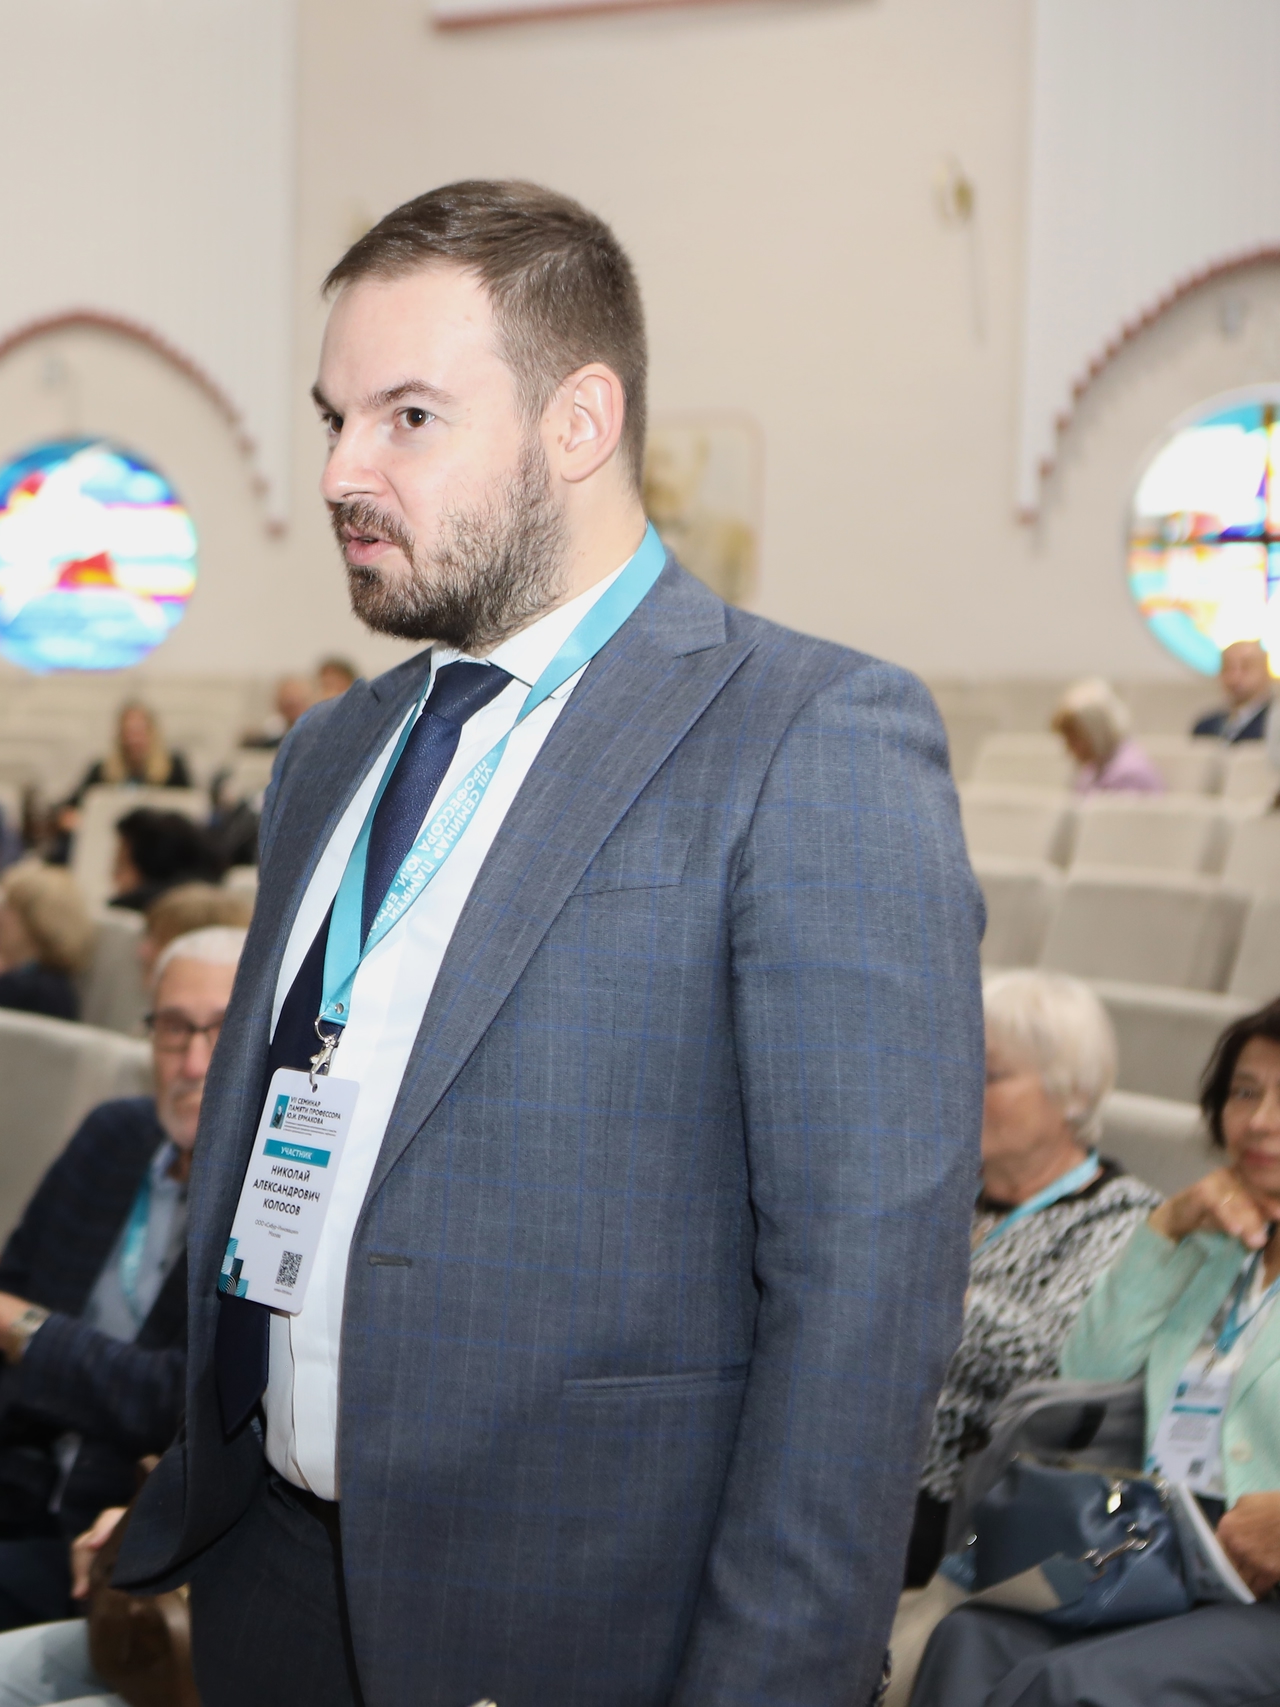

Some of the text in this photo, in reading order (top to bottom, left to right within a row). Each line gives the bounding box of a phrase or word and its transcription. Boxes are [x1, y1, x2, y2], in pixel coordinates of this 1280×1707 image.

[417, 760, 488, 852] ПРОФЕССОРА
[388, 767, 494, 920] VII СЕМИНАР ПАМЯТИ
[298, 1097, 321, 1108] СЕМИНАР
[297, 1114, 324, 1125] ЕРМАКОВА
[309, 1107, 341, 1120] ПРОФЕССОРА
[280, 1146, 313, 1160] УЧАСТНИК
[271, 1164, 311, 1182] НИКОЛАЙ
[252, 1178, 321, 1203] АЛЕКСАНДРОВИЧ
[262, 1198, 301, 1216] КОЛОСОВ
